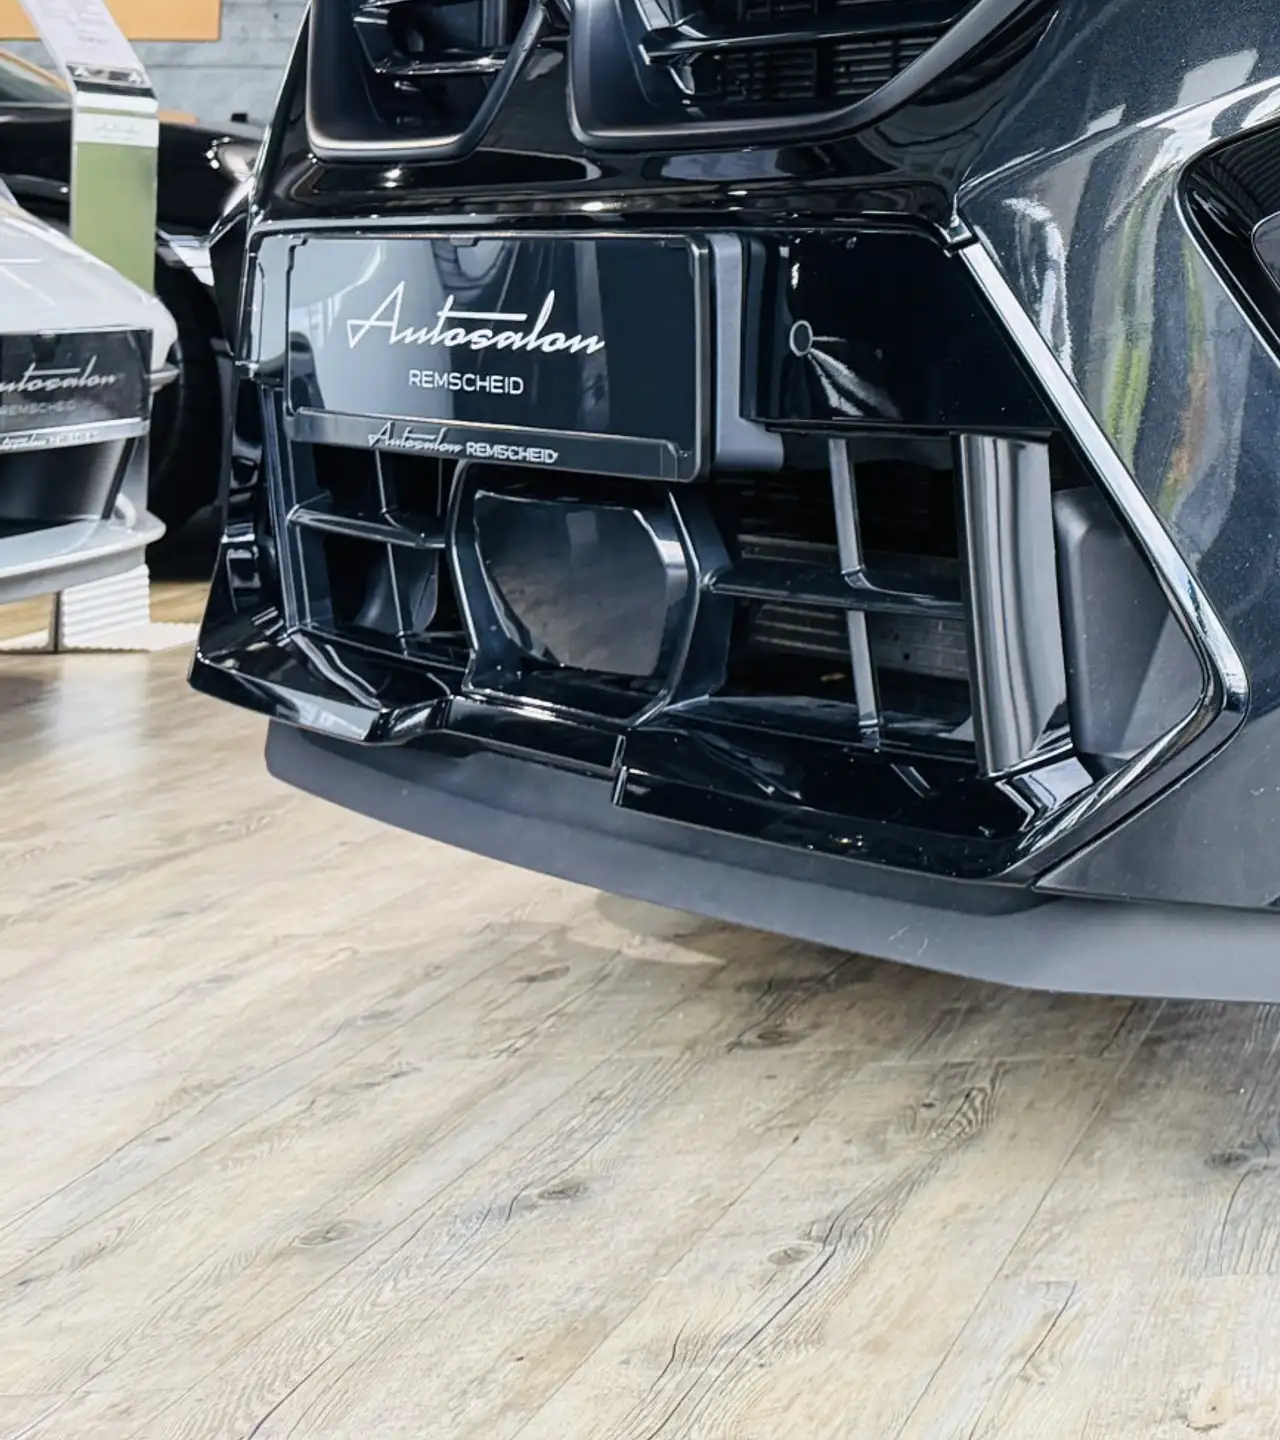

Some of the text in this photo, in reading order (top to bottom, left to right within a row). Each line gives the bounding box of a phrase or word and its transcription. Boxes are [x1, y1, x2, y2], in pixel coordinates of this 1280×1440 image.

[346, 280, 605, 354] Autosalon
[0, 354, 125, 393] utosalon
[408, 368, 524, 396] REMSCHEID
[367, 421, 559, 464] Autosalon REMSCHEID
